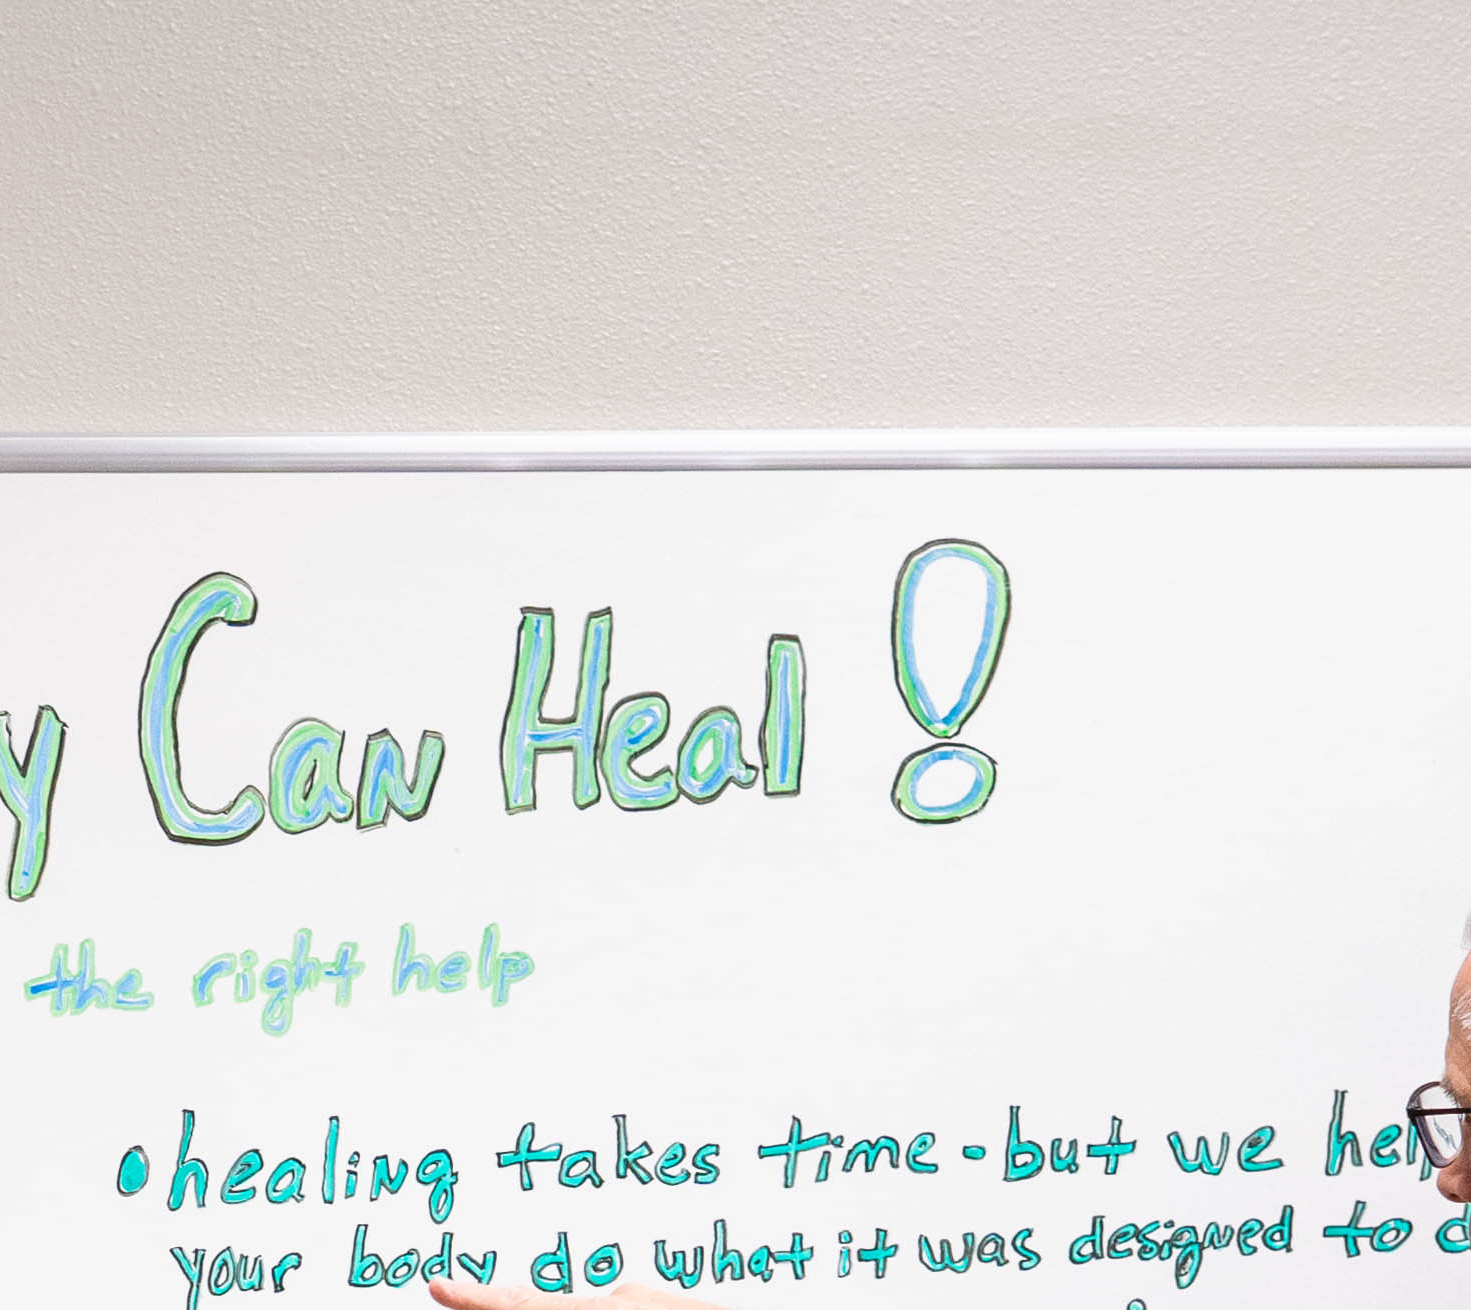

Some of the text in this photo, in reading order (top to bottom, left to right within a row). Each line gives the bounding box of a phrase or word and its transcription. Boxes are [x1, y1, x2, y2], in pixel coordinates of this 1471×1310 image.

[138, 572, 445, 846] Can
[500, 607, 806, 812] Heal
[891, 539, 1011, 824] !
[25, 939, 151, 1016] the
[193, 928, 363, 1033] right
[393, 924, 534, 1007] help
[496, 1116, 719, 1191] takes
[1167, 1126, 1283, 1176] we
[349, 1223, 494, 1291] body
[531, 1233, 630, 1296] do
[654, 1219, 813, 1289] what
[838, 1228, 898, 1279] it
[919, 1228, 1041, 1273] was
[1069, 1205, 1293, 1289] designed
[1323, 1206, 1413, 1258] to
